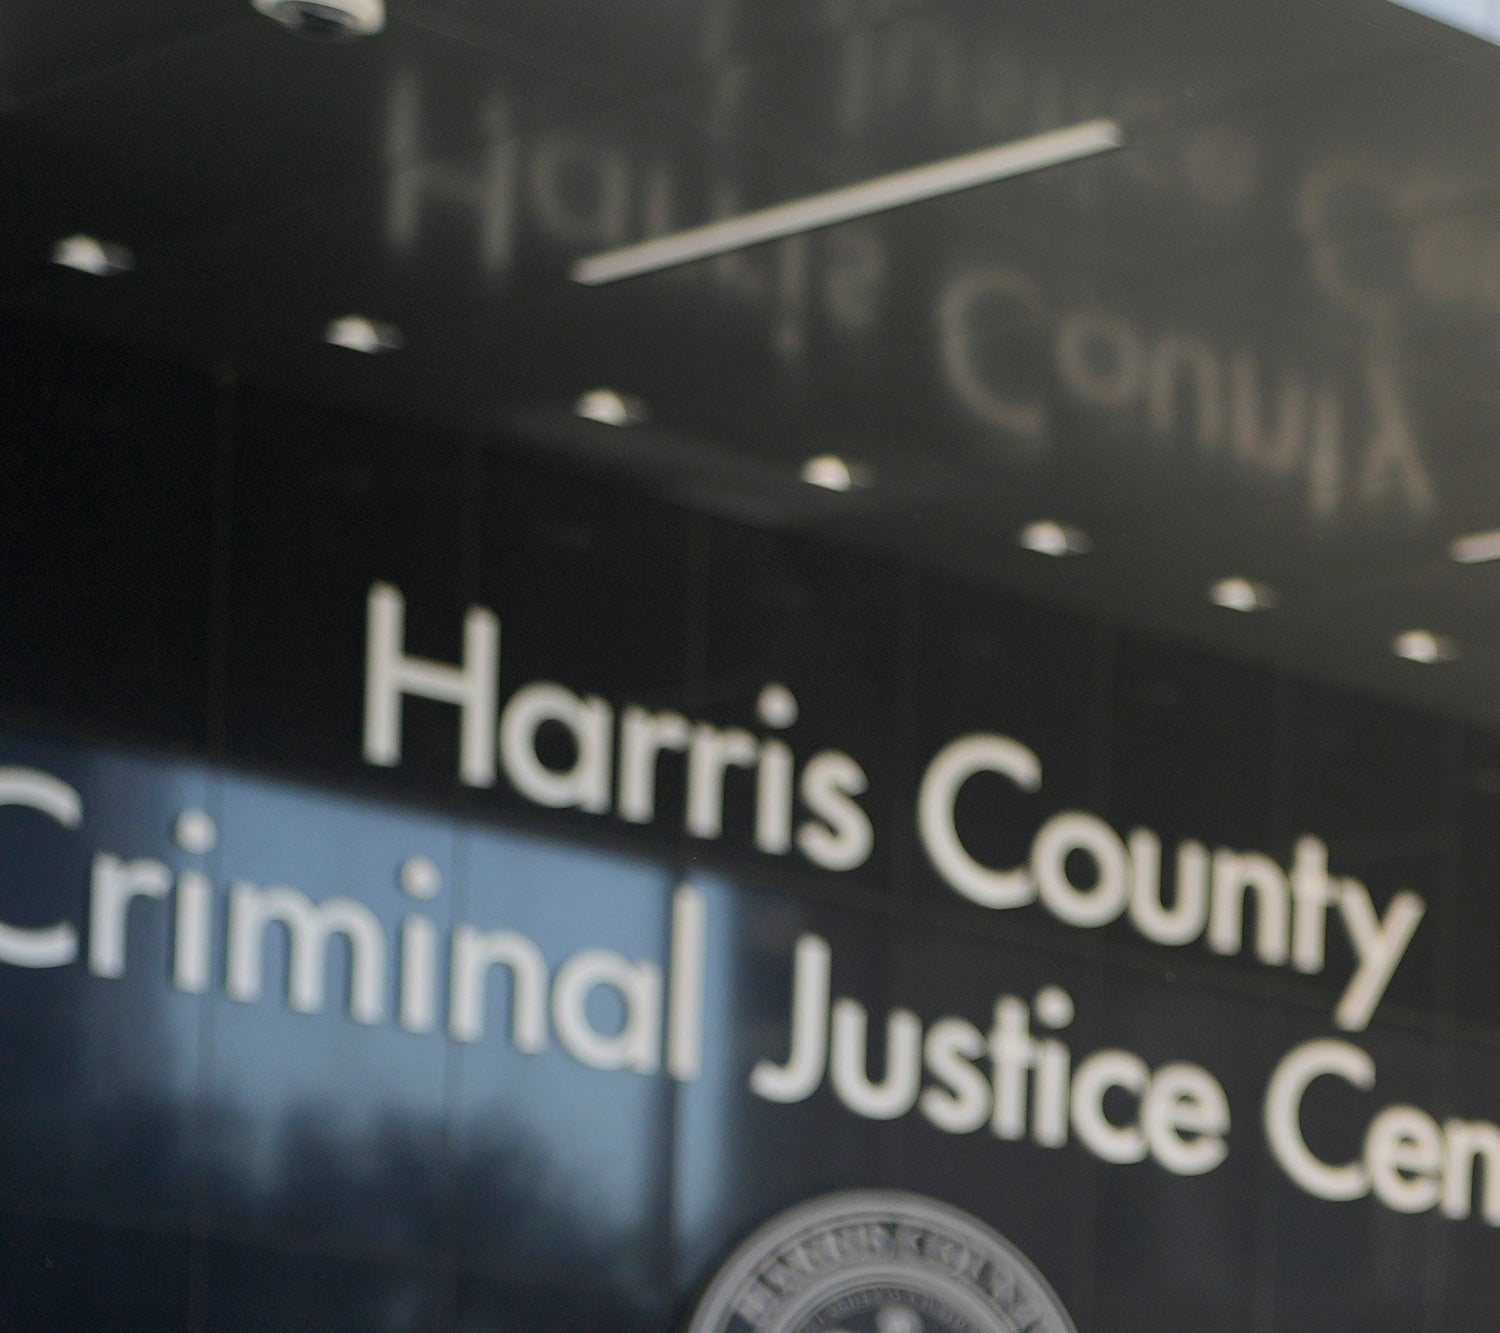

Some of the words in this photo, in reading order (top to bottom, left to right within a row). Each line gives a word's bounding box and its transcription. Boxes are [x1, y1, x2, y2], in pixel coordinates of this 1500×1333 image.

[0, 767, 707, 1083] Criminal
[750, 932, 1230, 1175] Justice
[362, 580, 873, 872] Harris
[917, 732, 1425, 1031] County
